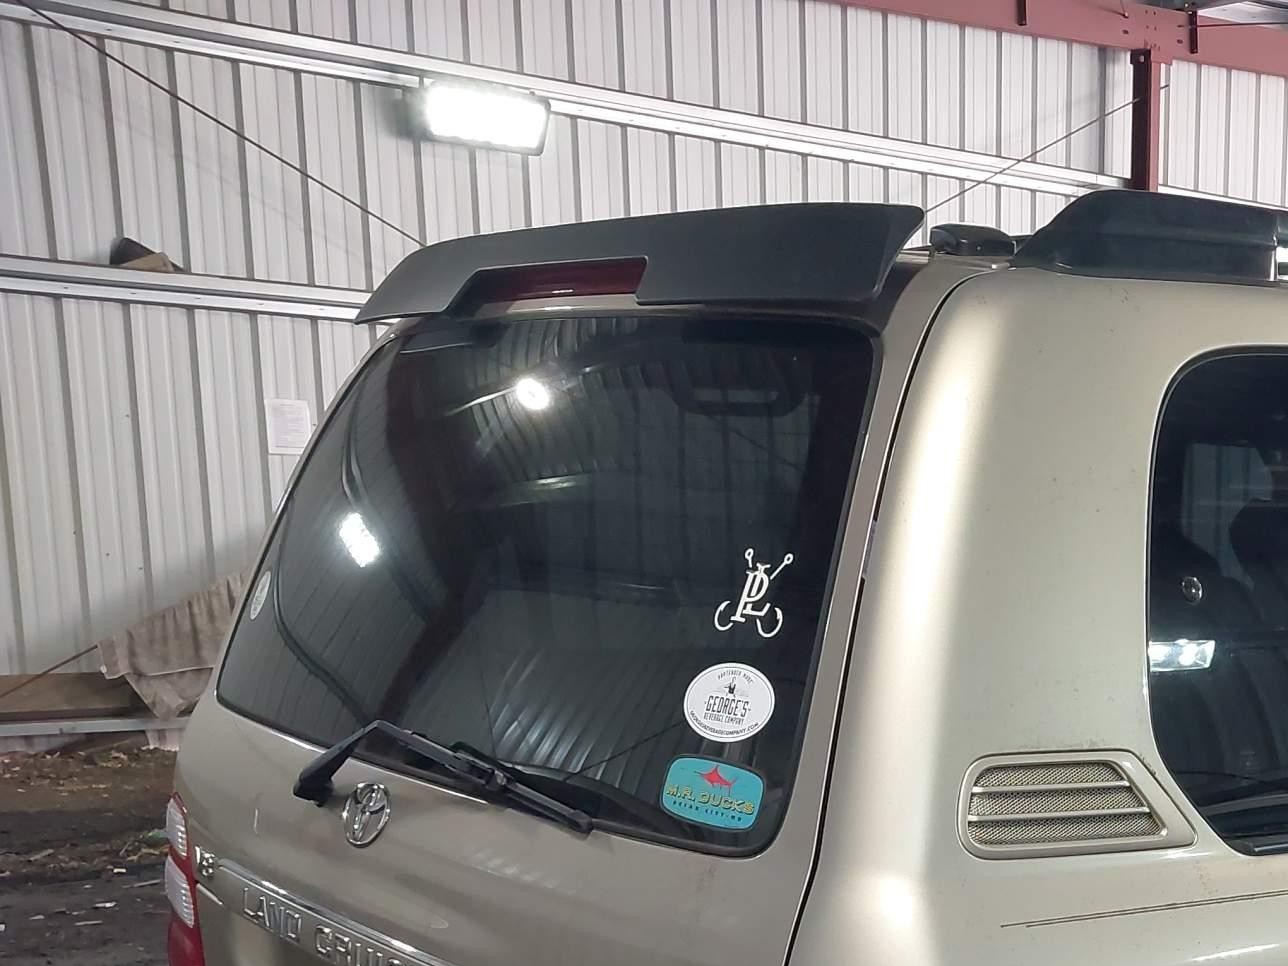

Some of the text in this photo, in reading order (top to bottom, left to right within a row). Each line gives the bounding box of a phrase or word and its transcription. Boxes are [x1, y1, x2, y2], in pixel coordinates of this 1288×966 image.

[705, 695, 749, 718] GEORGE'S
[725, 715, 745, 725] COMPANY
[697, 791, 755, 816] DUCKS
[242, 887, 302, 942] LAND
